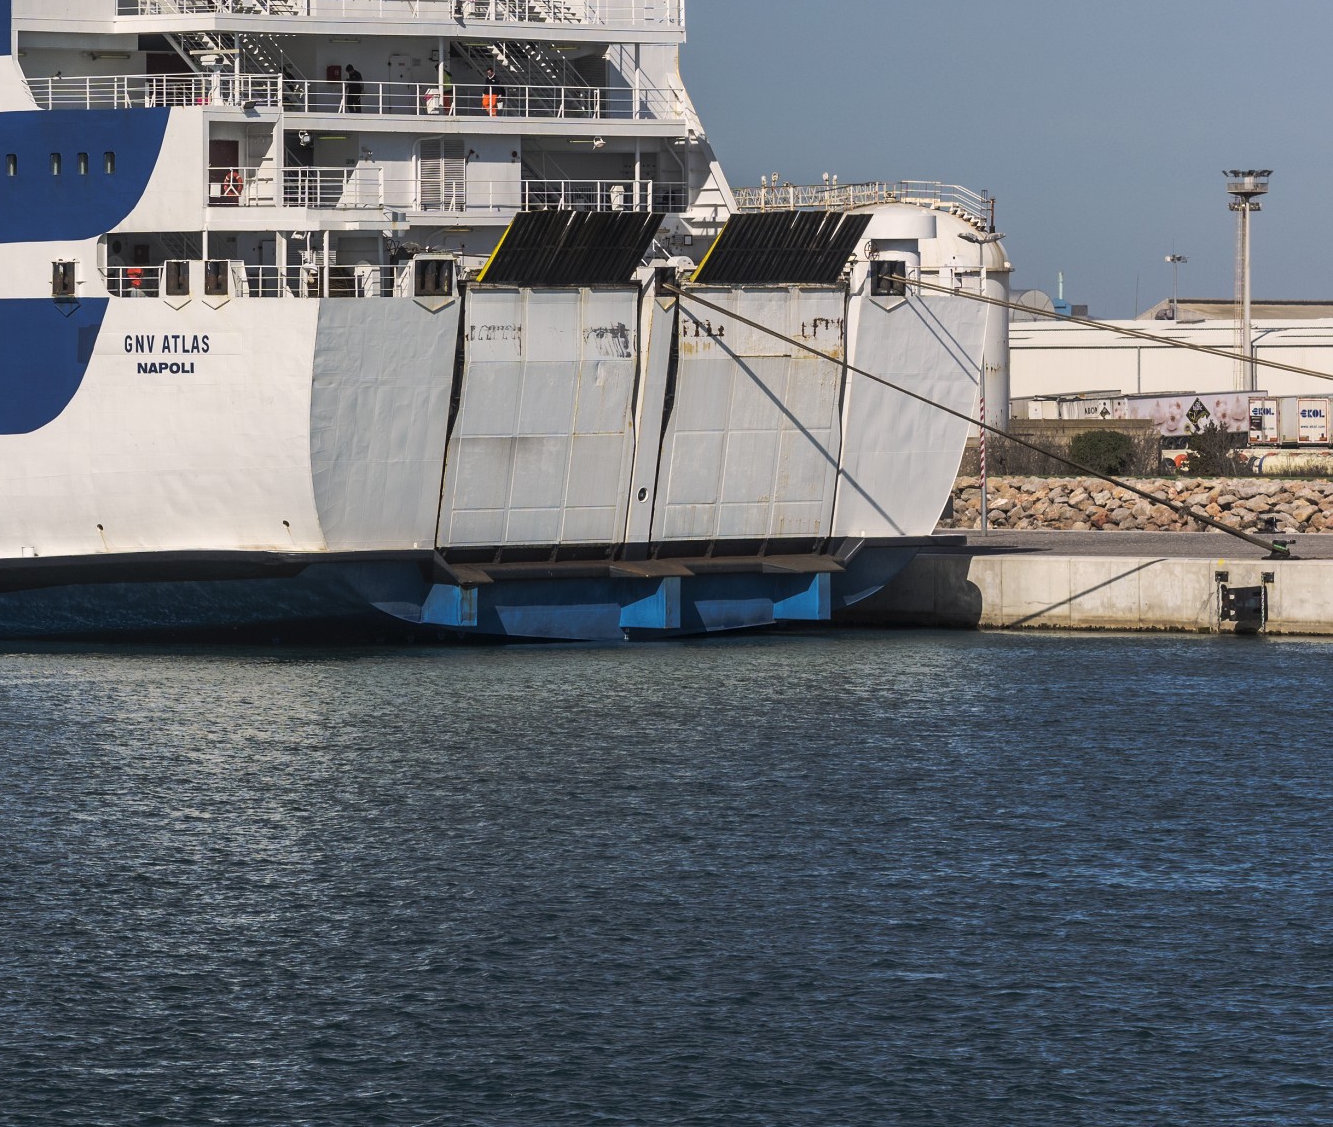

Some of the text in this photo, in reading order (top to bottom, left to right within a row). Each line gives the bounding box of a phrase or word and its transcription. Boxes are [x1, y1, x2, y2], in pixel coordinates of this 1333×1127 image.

[124, 334, 210, 353] GNV ATLAS
[137, 362, 195, 374] NAPOLI
